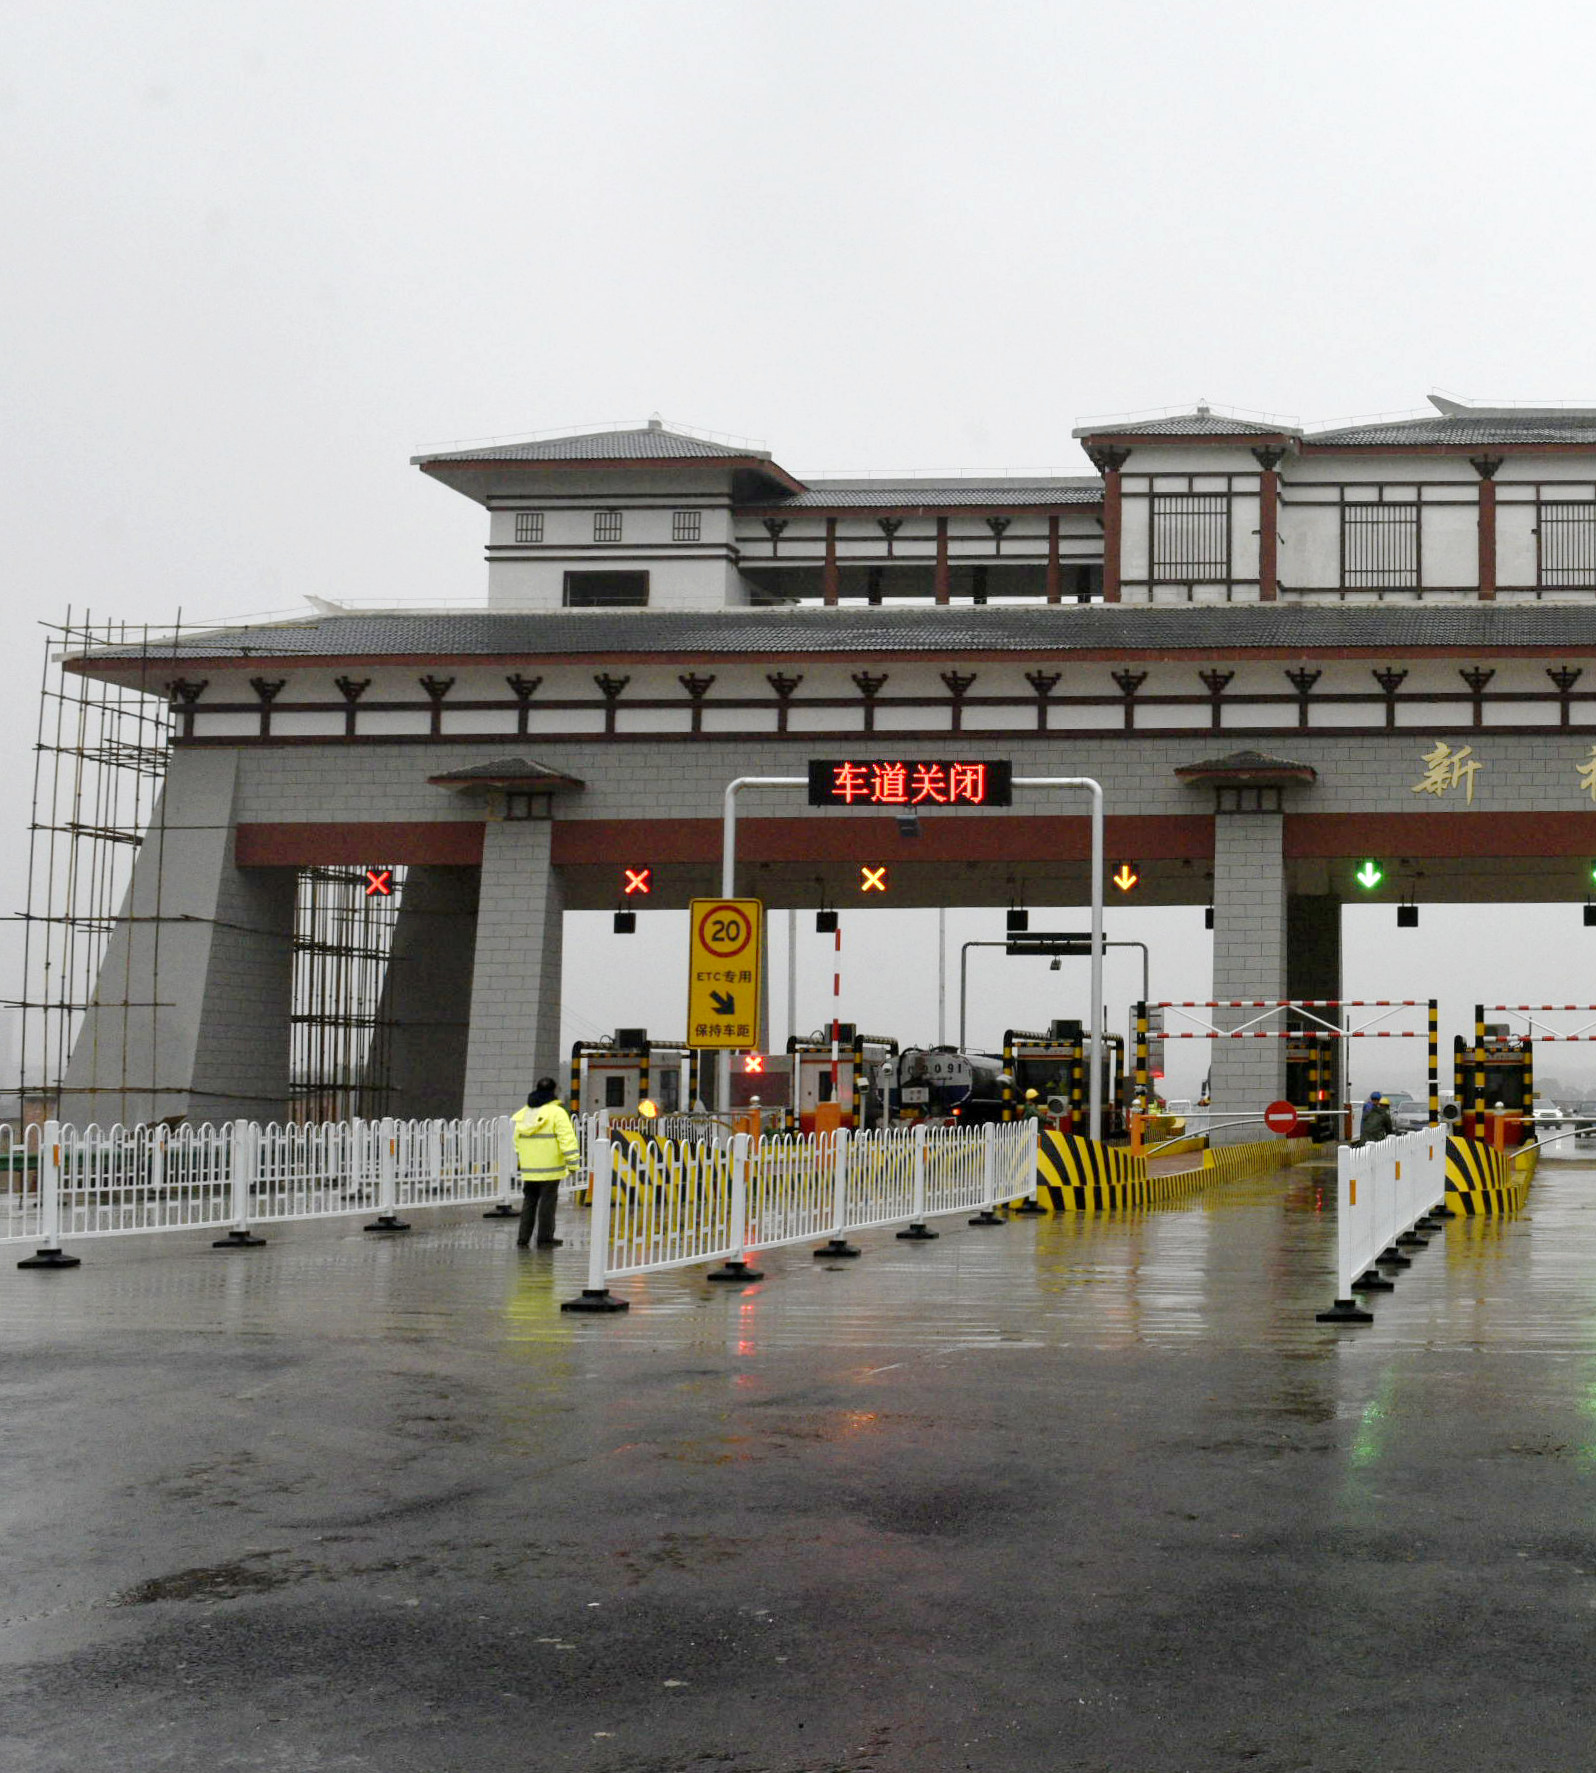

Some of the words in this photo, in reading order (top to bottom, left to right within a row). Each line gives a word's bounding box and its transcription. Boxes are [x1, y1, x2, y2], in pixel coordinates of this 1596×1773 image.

[832, 761, 986, 804] 车道关闭
[711, 919, 740, 942] 20
[695, 1023, 751, 1038] 保持车距
